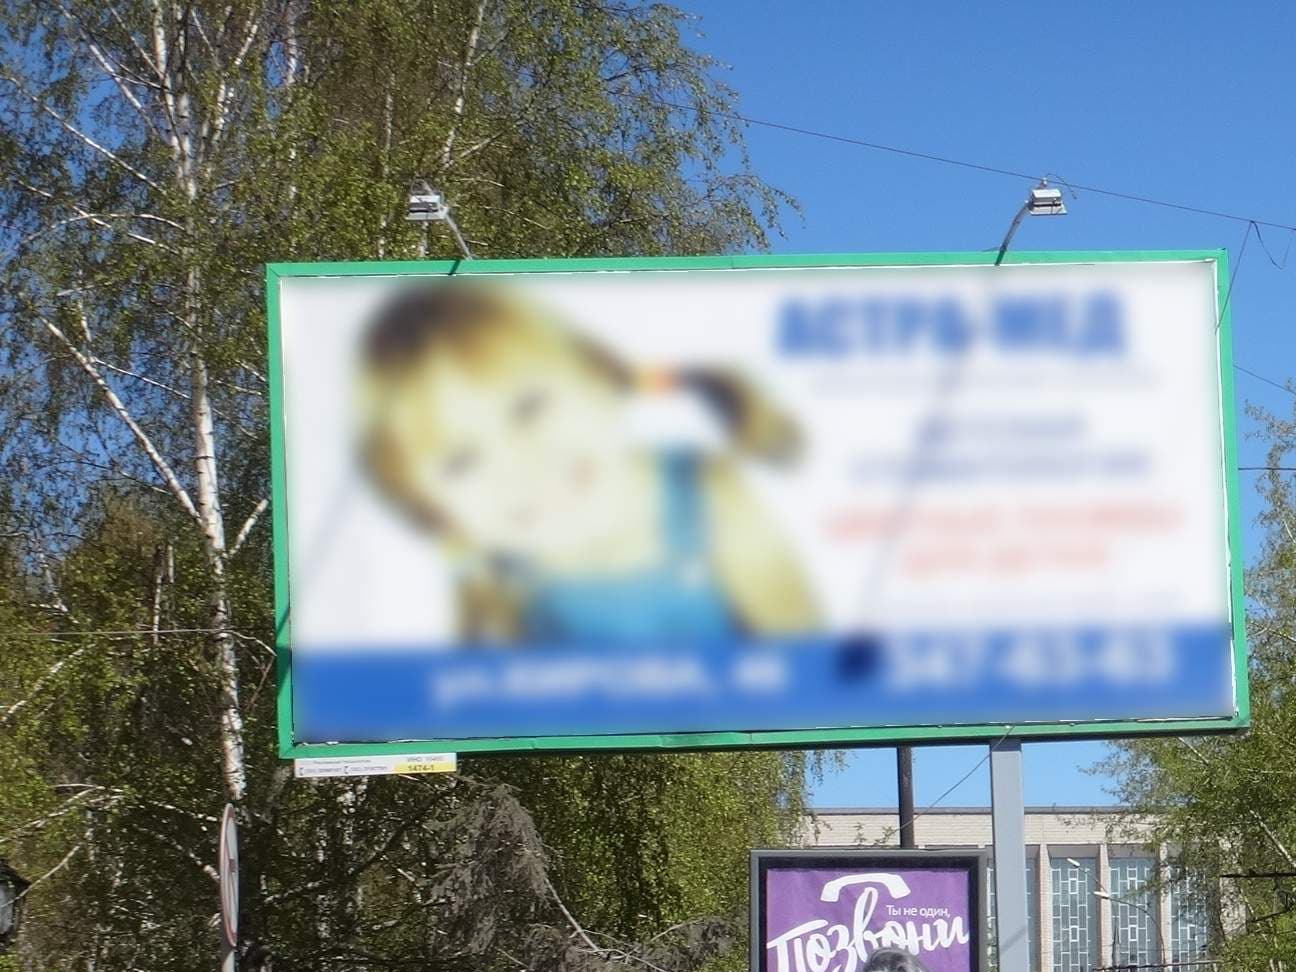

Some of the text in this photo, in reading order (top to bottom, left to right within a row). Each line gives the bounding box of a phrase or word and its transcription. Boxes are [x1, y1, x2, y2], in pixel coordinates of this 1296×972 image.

[886, 905, 951, 918] Ты не один,
